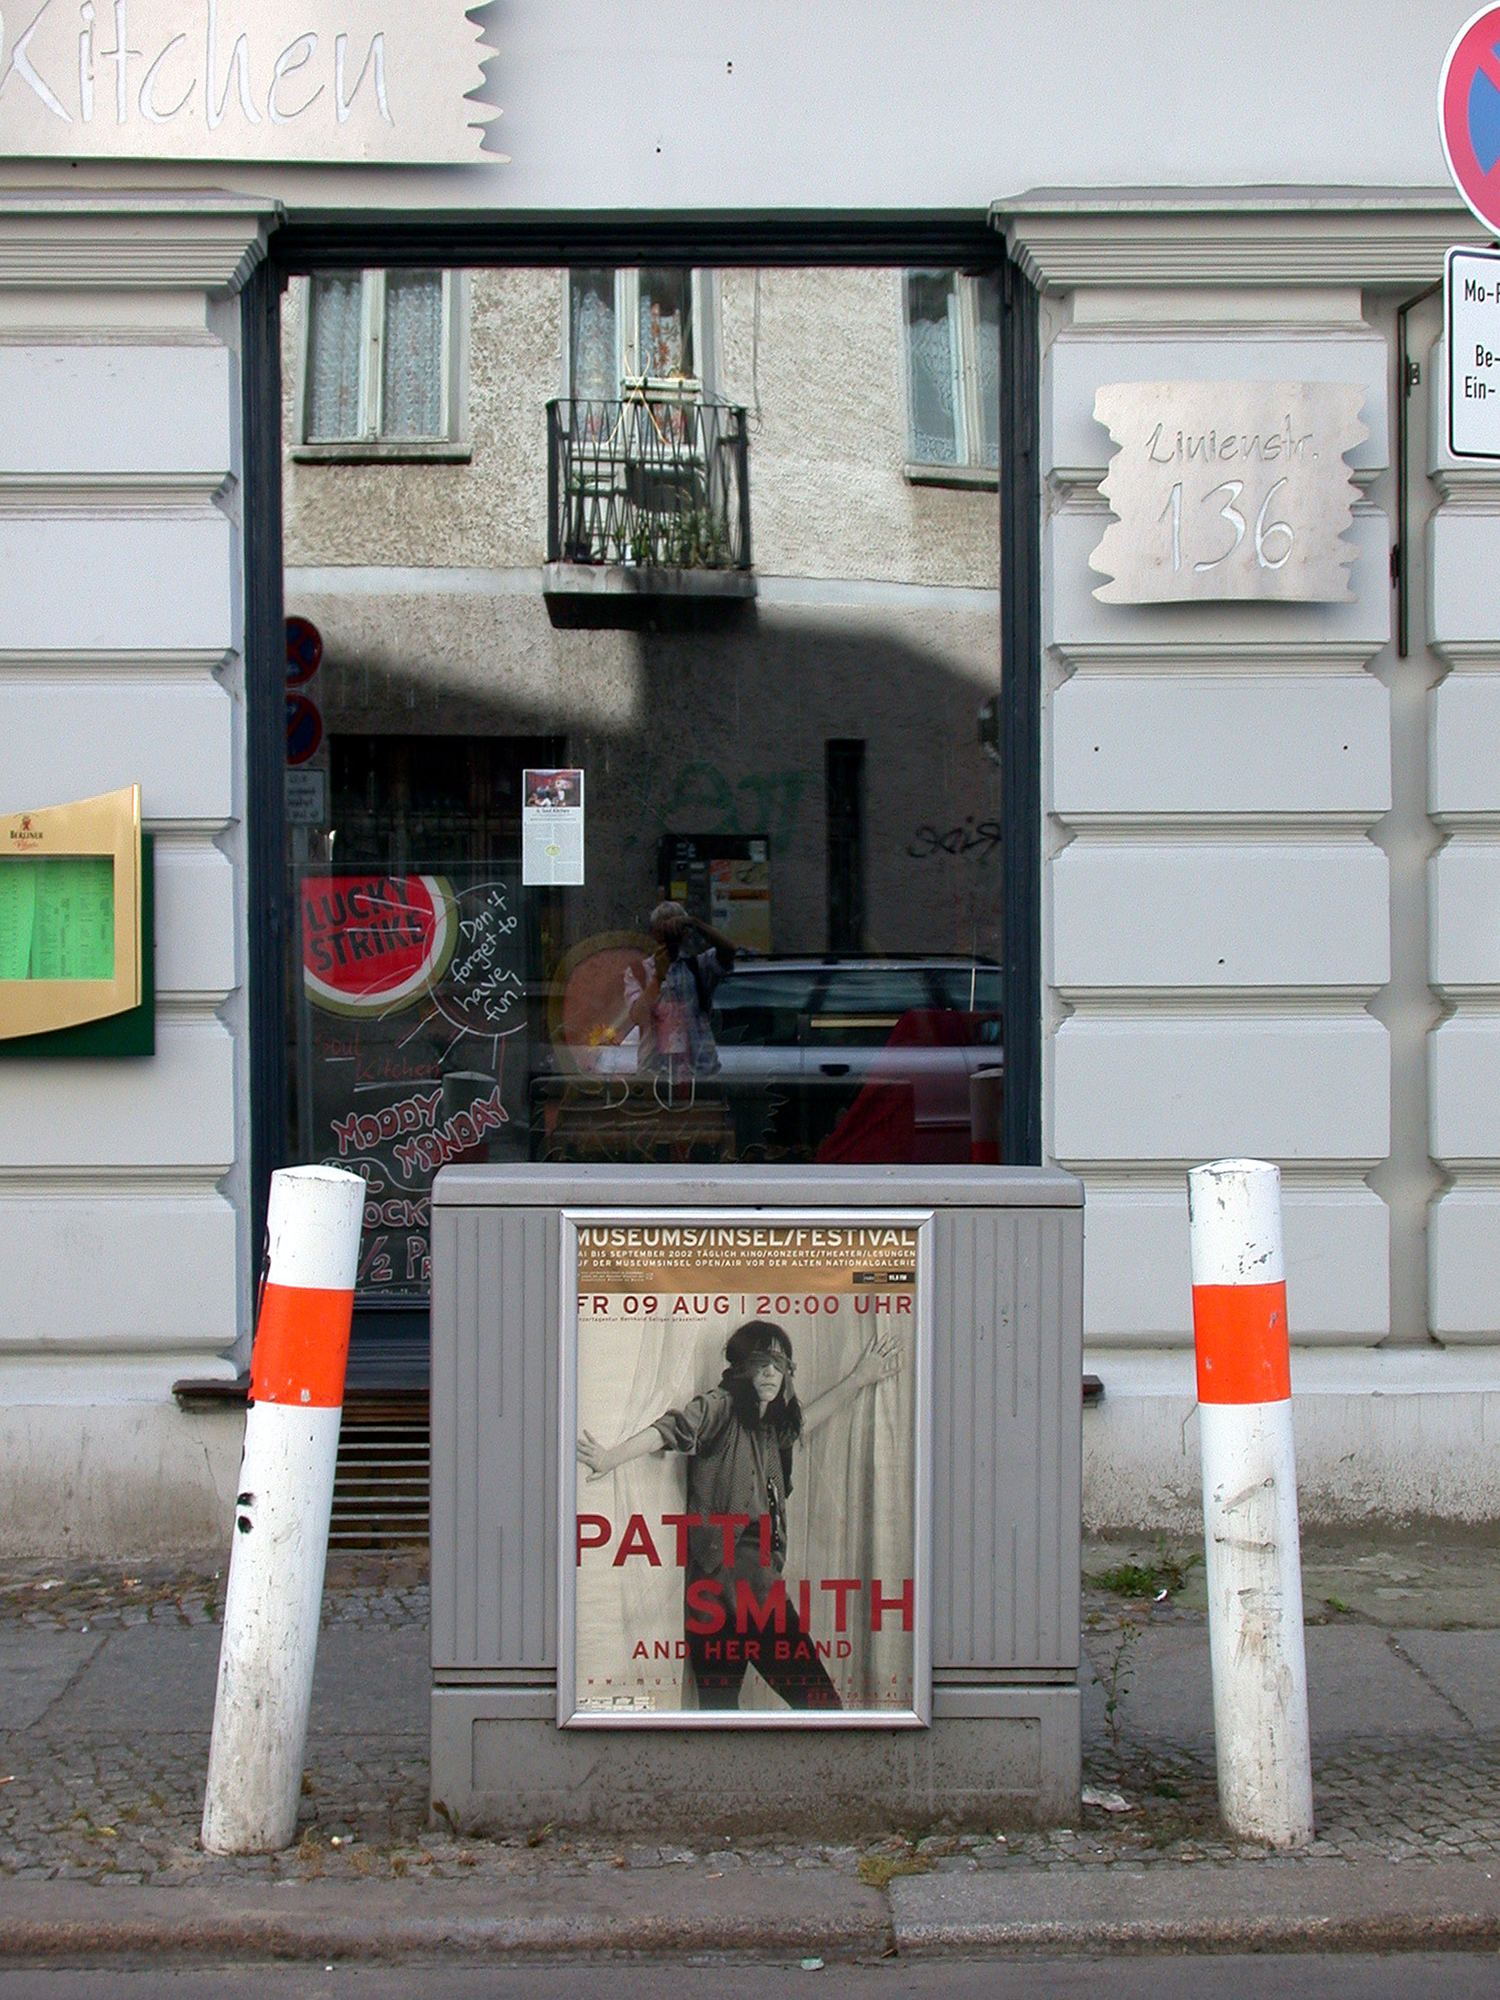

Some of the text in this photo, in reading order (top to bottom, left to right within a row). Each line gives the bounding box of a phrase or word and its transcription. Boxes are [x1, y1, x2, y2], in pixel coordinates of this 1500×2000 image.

[0, 0, 395, 130] Kitchen
[1465, 279, 1500, 303] Mo-
[1465, 376, 1496, 400] Ein-
[1146, 414, 1319, 463] Linienstr.
[1158, 477, 1294, 572] 136
[305, 877, 408, 932] LUCKY
[459, 891, 507, 943] Don't
[311, 911, 425, 971] STRIKE
[451, 916, 518, 985] forget to
[453, 967, 511, 1012] have
[484, 973, 527, 1021] fun!
[331, 1087, 444, 1155] MOODY
[393, 1085, 510, 1179] MONDAY
[362, 1197, 431, 1228] OCK
[578, 1228, 915, 1247] MUSEUMS/INSEL/FESTIVAL
[591, 1250, 606, 1258] BIS
[610, 1250, 665, 1258] SEPTEMBER
[669, 1250, 692, 1258] 2002
[697, 1248, 736, 1258] TÄGLICH
[593, 1259, 611, 1267] DER
[616, 1259, 691, 1267] MUSEUMSINSEL
[695, 1259, 741, 1268] OPEN/AIR
[746, 1259, 764, 1267] VOR
[769, 1259, 787, 1267] DER
[792, 1259, 821, 1267] ALTEN
[825, 1259, 916, 1267] NATIONALGALERIE
[578, 1296, 608, 1314] FR
[623, 1296, 658, 1314] 09
[672, 1296, 729, 1314] AUG
[756, 1296, 839, 1314] 20:00
[854, 1296, 912, 1314] UHR
[577, 1514, 771, 1567] PATTI
[686, 1579, 914, 1634] SMITH
[633, 1641, 852, 1660] AND HER BAND
